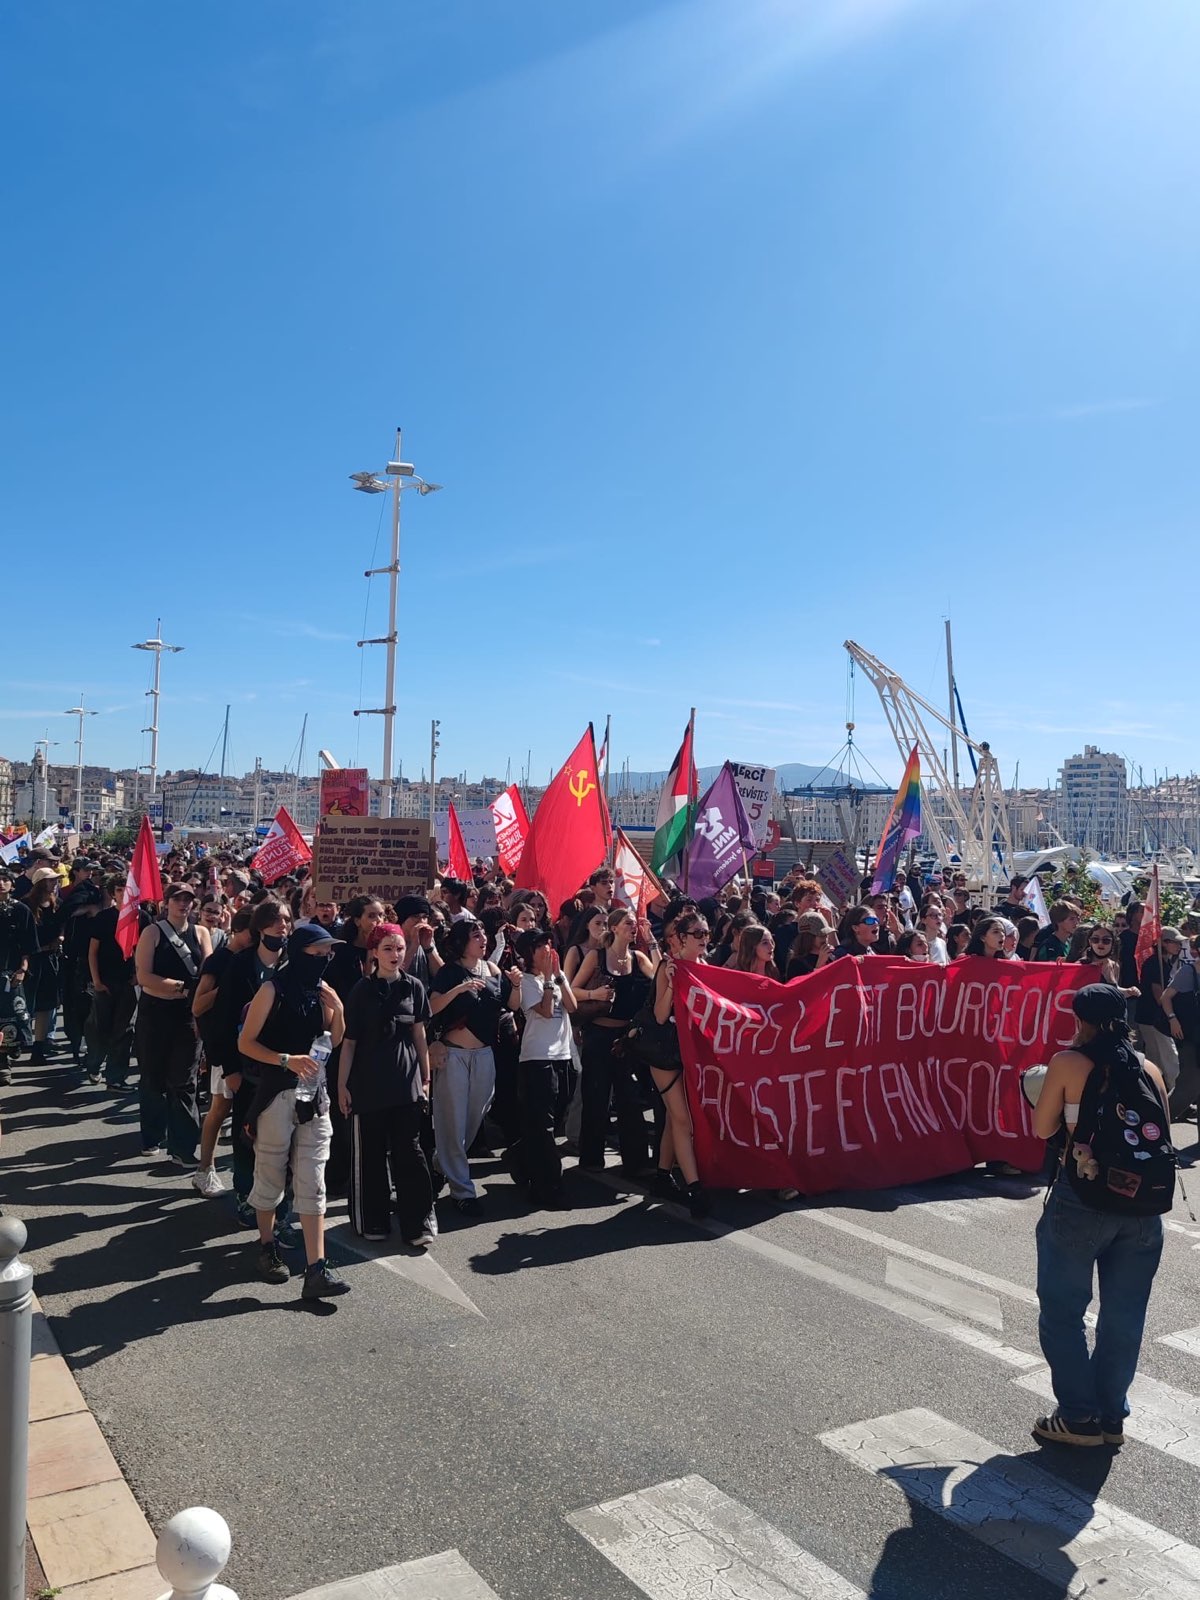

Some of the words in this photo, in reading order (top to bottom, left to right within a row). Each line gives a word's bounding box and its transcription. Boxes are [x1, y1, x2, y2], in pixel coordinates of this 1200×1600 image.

[749, 803, 764, 820] 5
[351, 857, 369, 866] 1800
[332, 886, 346, 900] ET
[713, 997, 784, 1056] BAS
[896, 980, 1080, 1046] BOURGEOIS
[837, 1065, 878, 1151] ET
